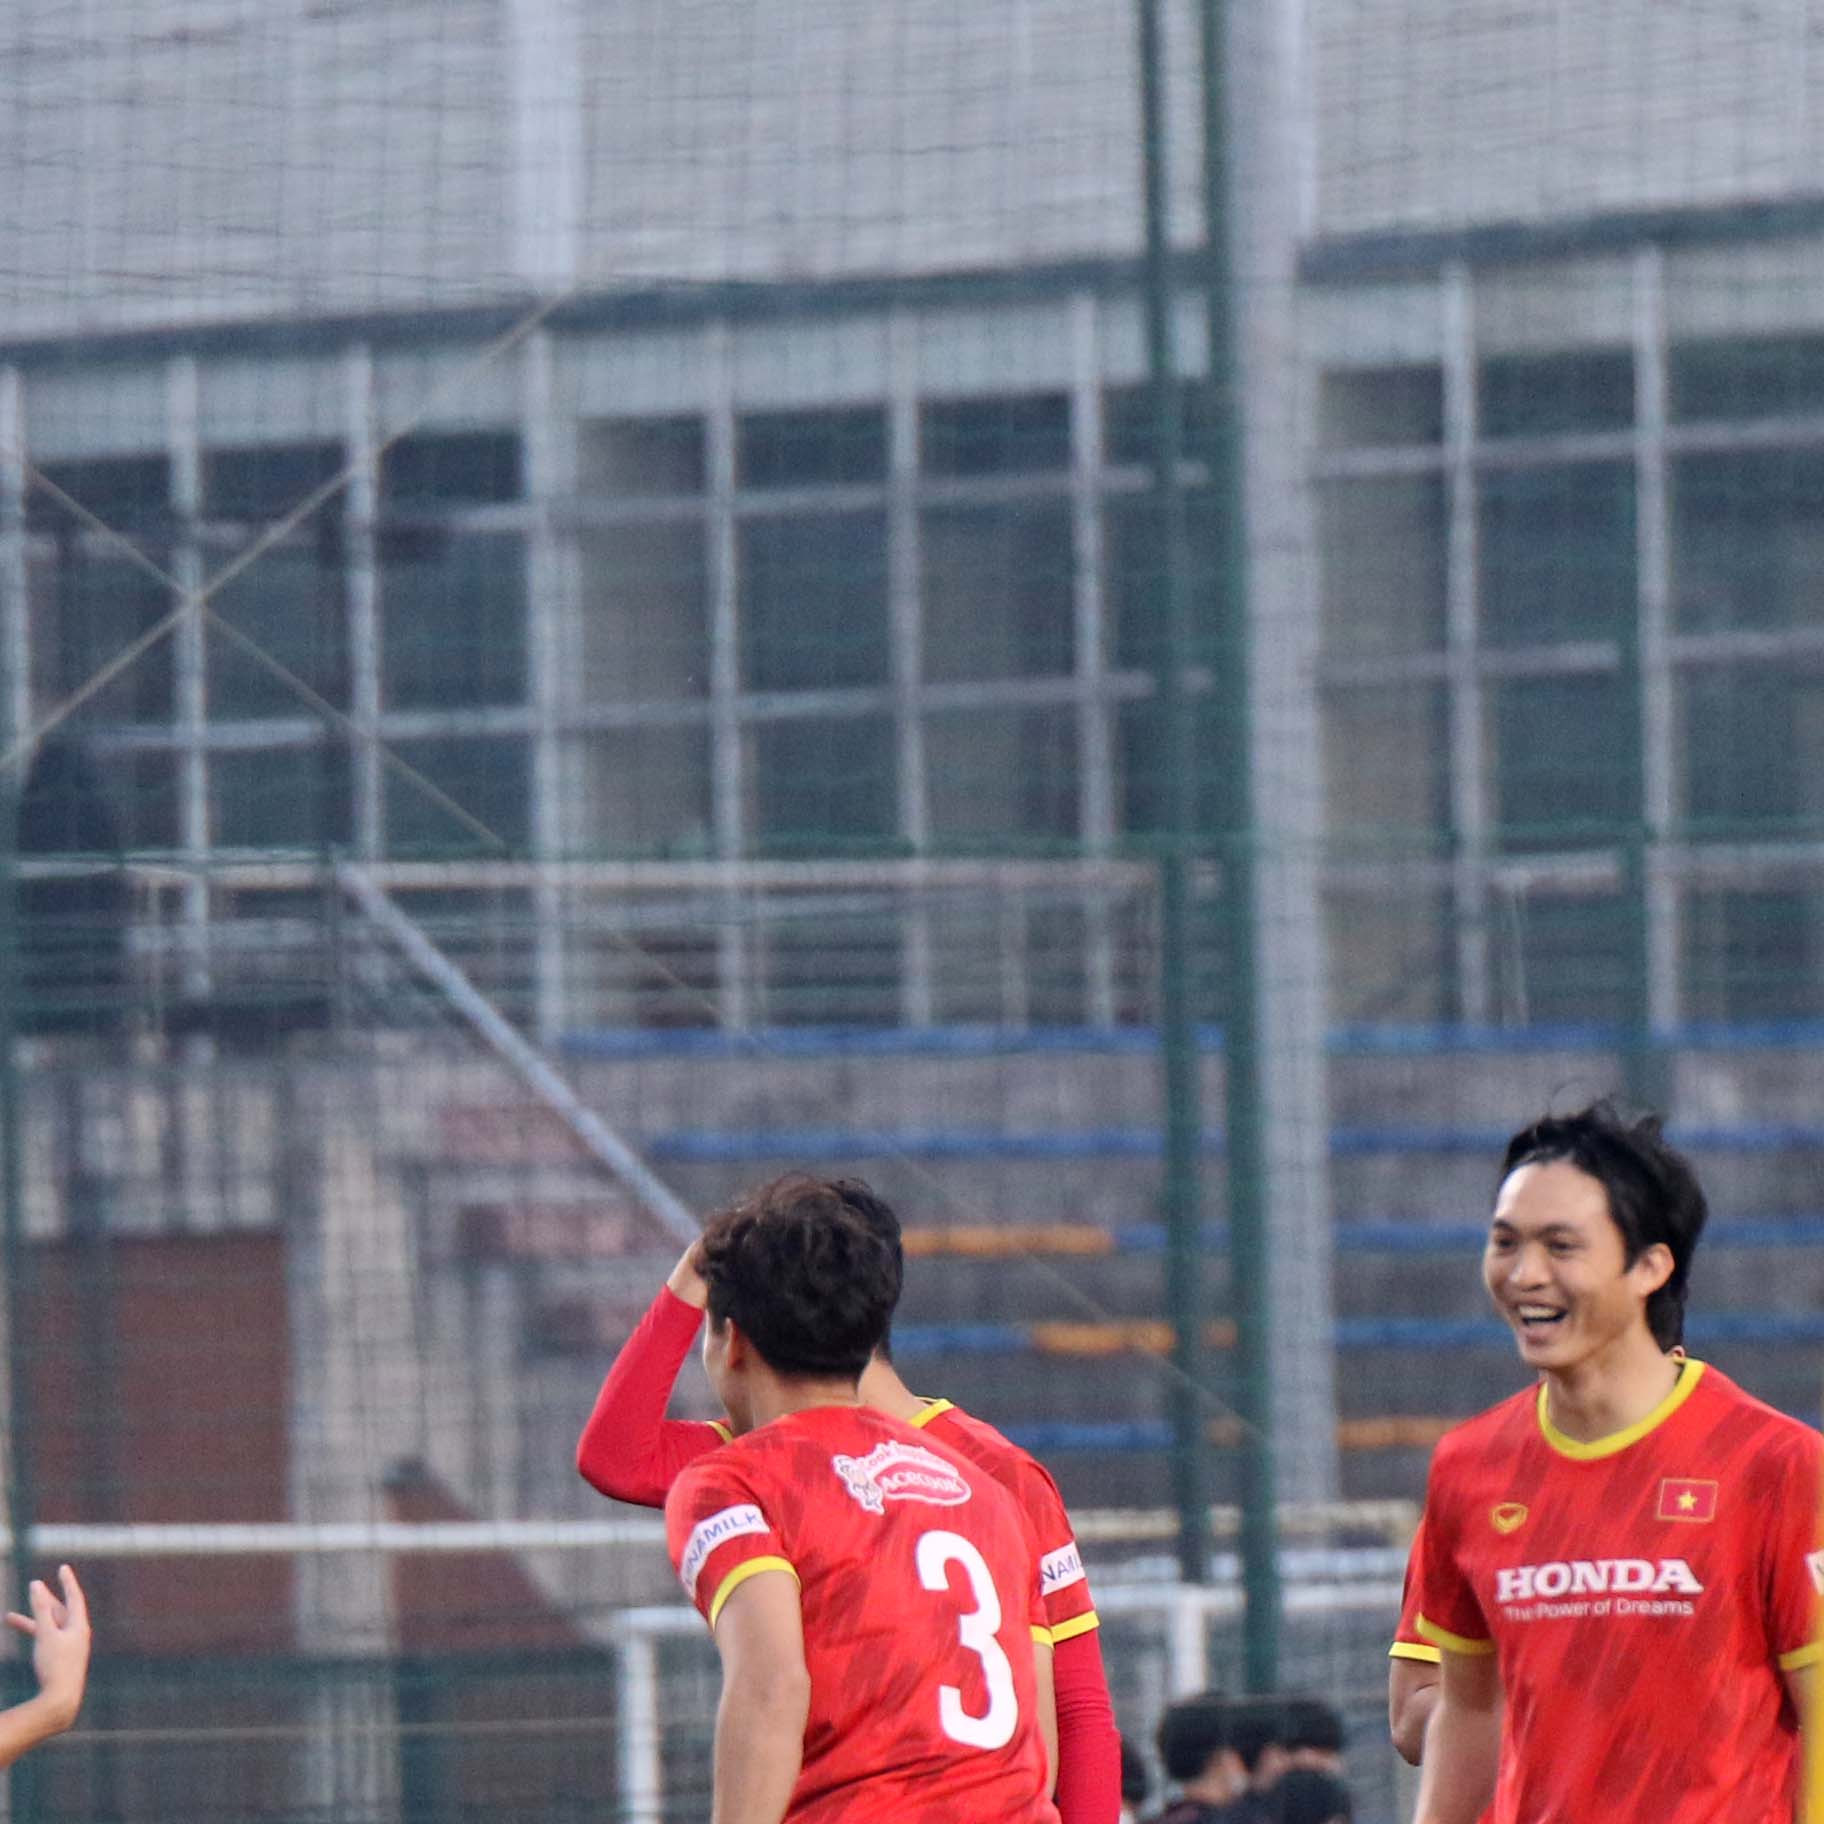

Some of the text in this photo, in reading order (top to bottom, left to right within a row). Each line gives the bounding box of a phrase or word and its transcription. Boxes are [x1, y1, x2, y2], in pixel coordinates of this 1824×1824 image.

[1496, 1559, 1704, 1603] HONDA
[1537, 1602, 1590, 1619] Power
[1594, 1598, 1611, 1614] of
[1616, 1597, 1693, 1616] Dreams
[916, 1530, 1019, 1750] 3
